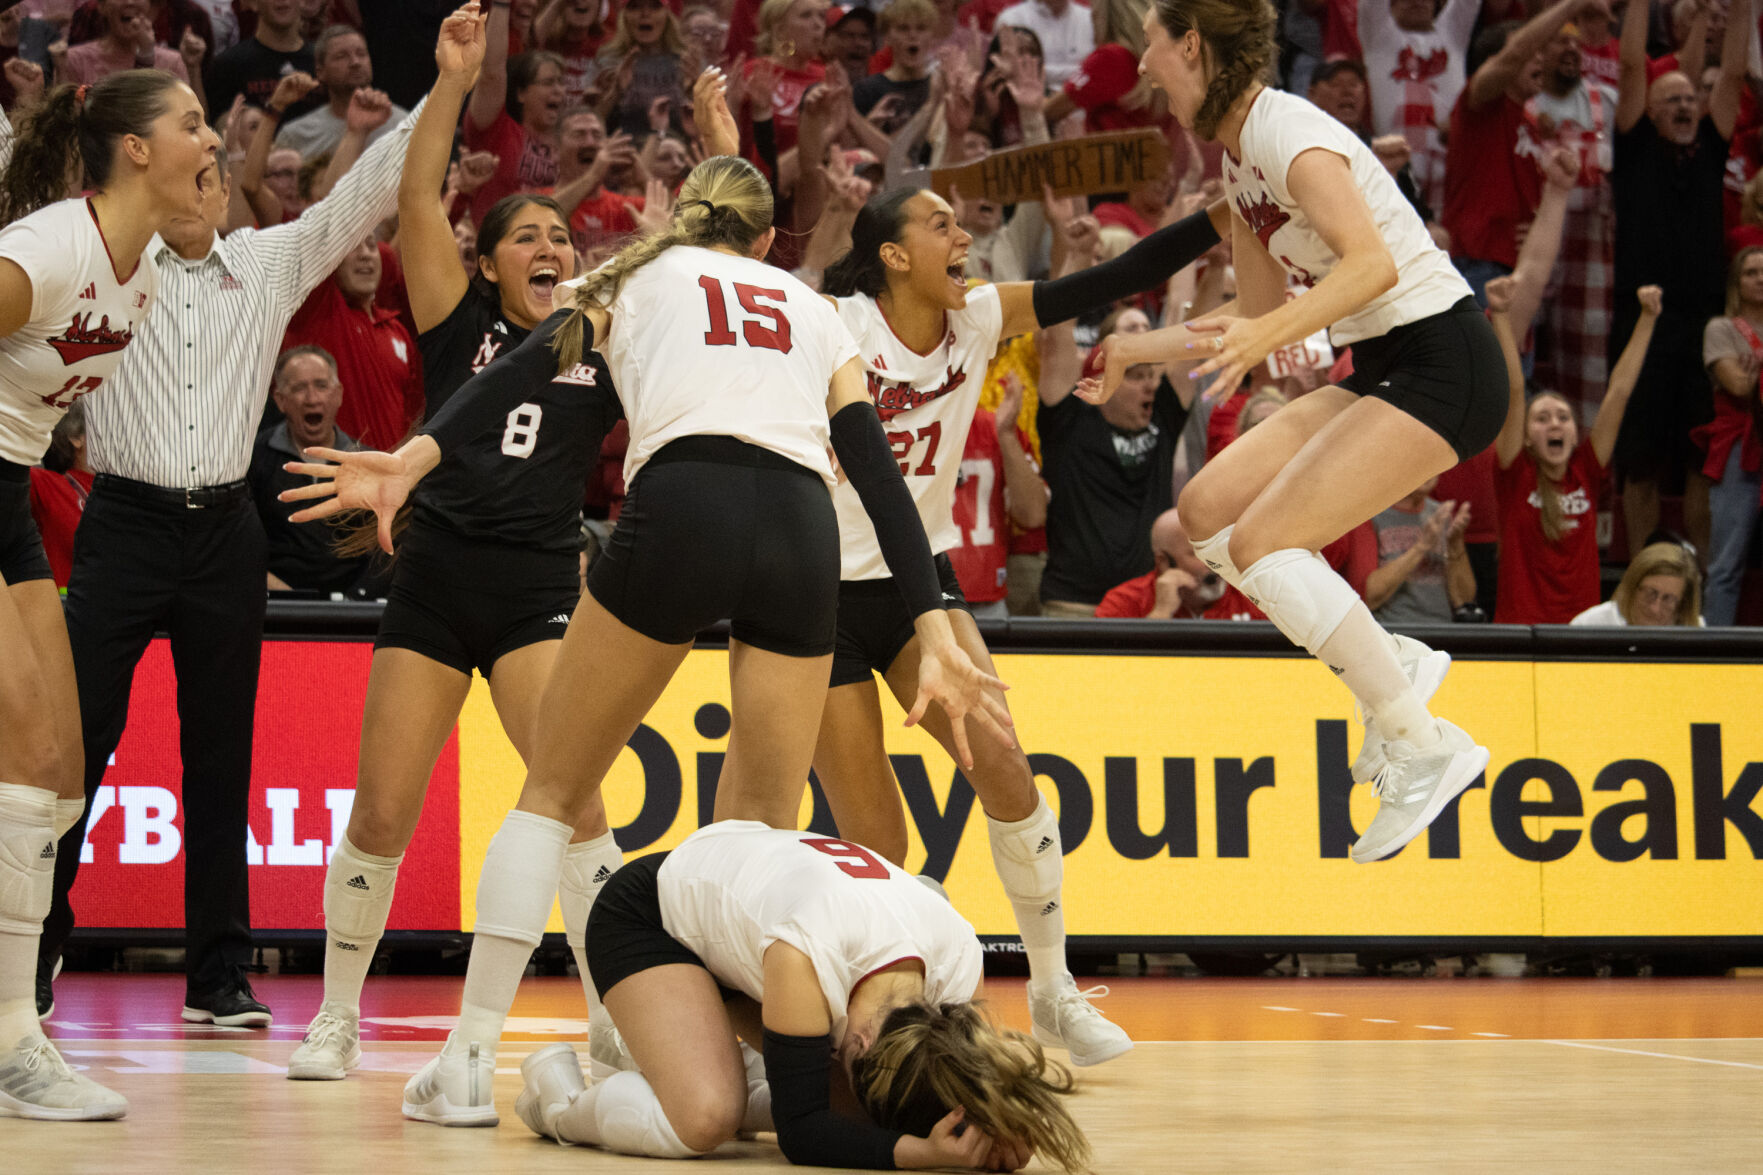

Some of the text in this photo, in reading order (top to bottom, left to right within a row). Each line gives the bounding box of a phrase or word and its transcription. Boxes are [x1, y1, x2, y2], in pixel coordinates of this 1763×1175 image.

[698, 274, 793, 355] 15
[501, 402, 543, 460] 8
[886, 420, 942, 477] 27
[1315, 718, 1763, 862] break
